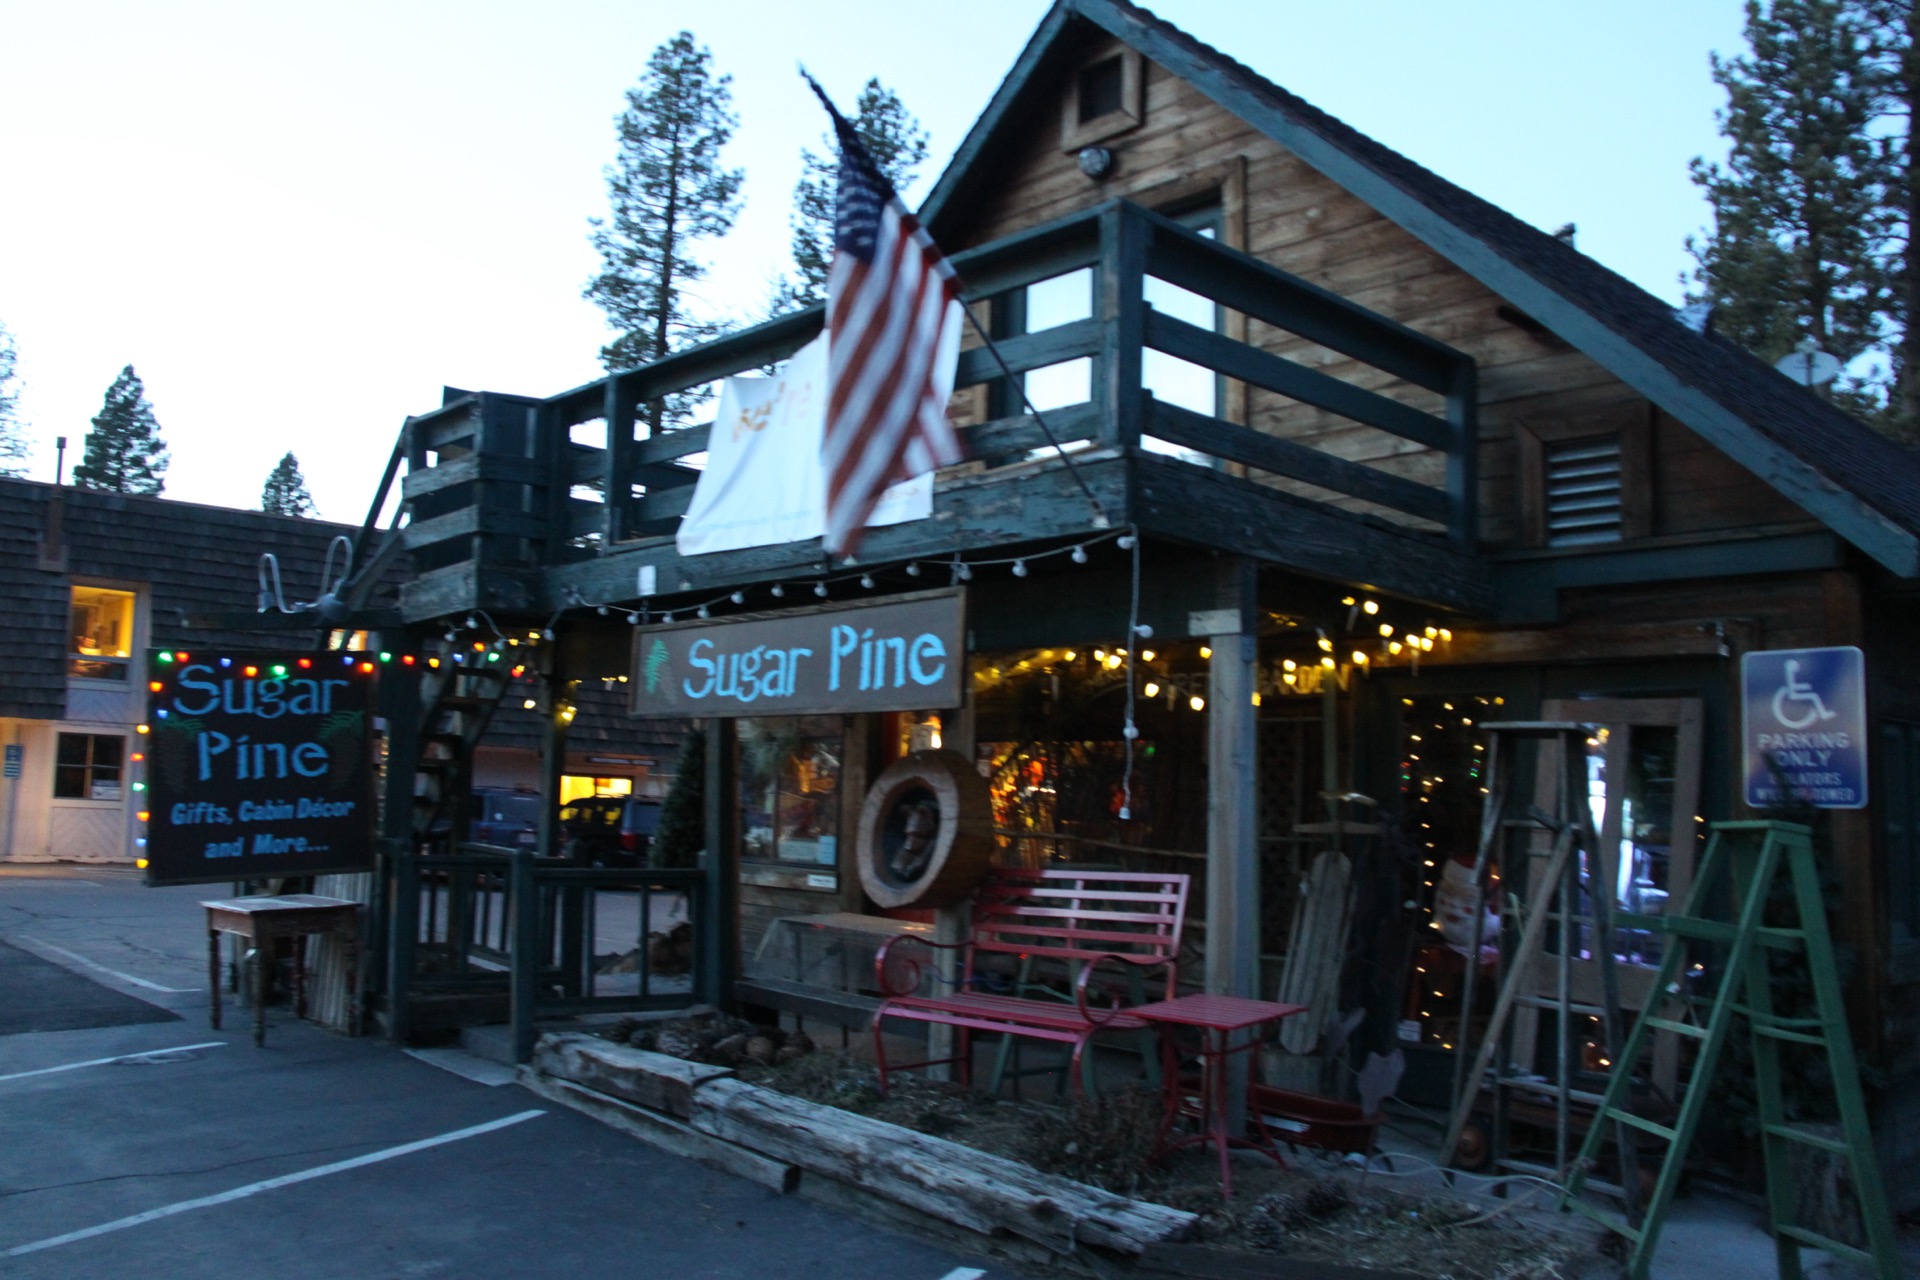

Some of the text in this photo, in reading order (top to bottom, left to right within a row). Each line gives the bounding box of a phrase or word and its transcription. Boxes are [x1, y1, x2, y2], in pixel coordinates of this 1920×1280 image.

[682, 624, 947, 702] Sugar Pine
[173, 664, 350, 719] Sugar
[1757, 732, 1849, 749] PARKING
[198, 730, 329, 781] Pine
[1775, 750, 1832, 767] ONLY
[171, 797, 355, 825] Gifts, Cabin Décor
[204, 837, 244, 859] and
